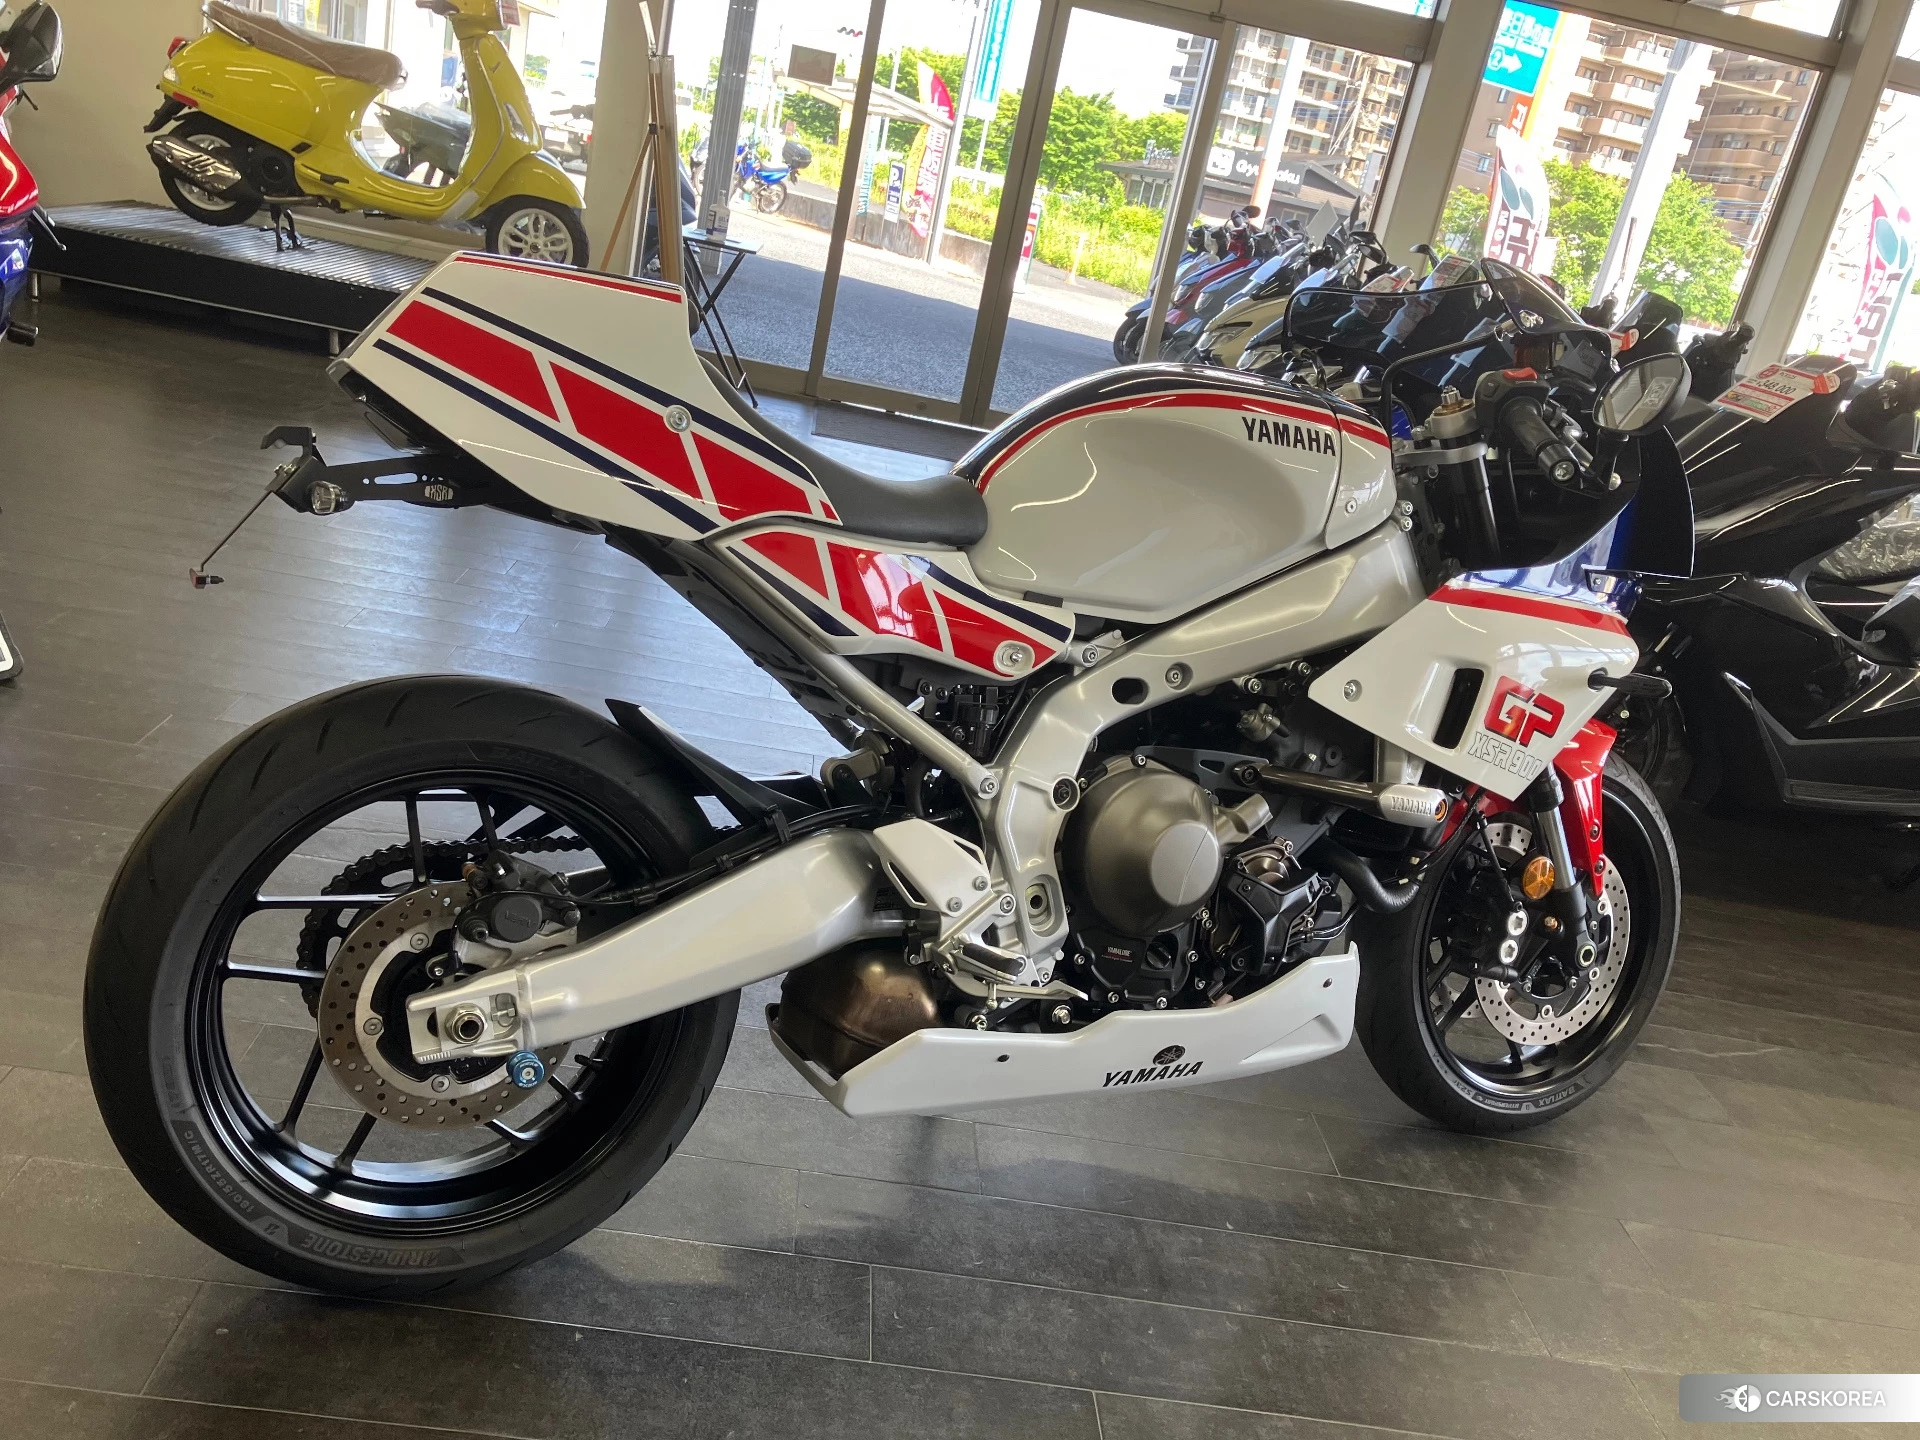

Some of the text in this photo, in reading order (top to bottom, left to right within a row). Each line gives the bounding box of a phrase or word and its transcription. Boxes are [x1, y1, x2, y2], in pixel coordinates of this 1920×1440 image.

[1241, 416, 1336, 457] YAMAHA
[430, 484, 448, 502] XSR
[1484, 675, 1565, 748] GP
[1391, 796, 1432, 817] YAMAHA
[1102, 1061, 1203, 1087] YAMAHA
[1538, 1084, 1575, 1107] BATTLAX
[301, 1233, 439, 1267] BRIDGESTONE
